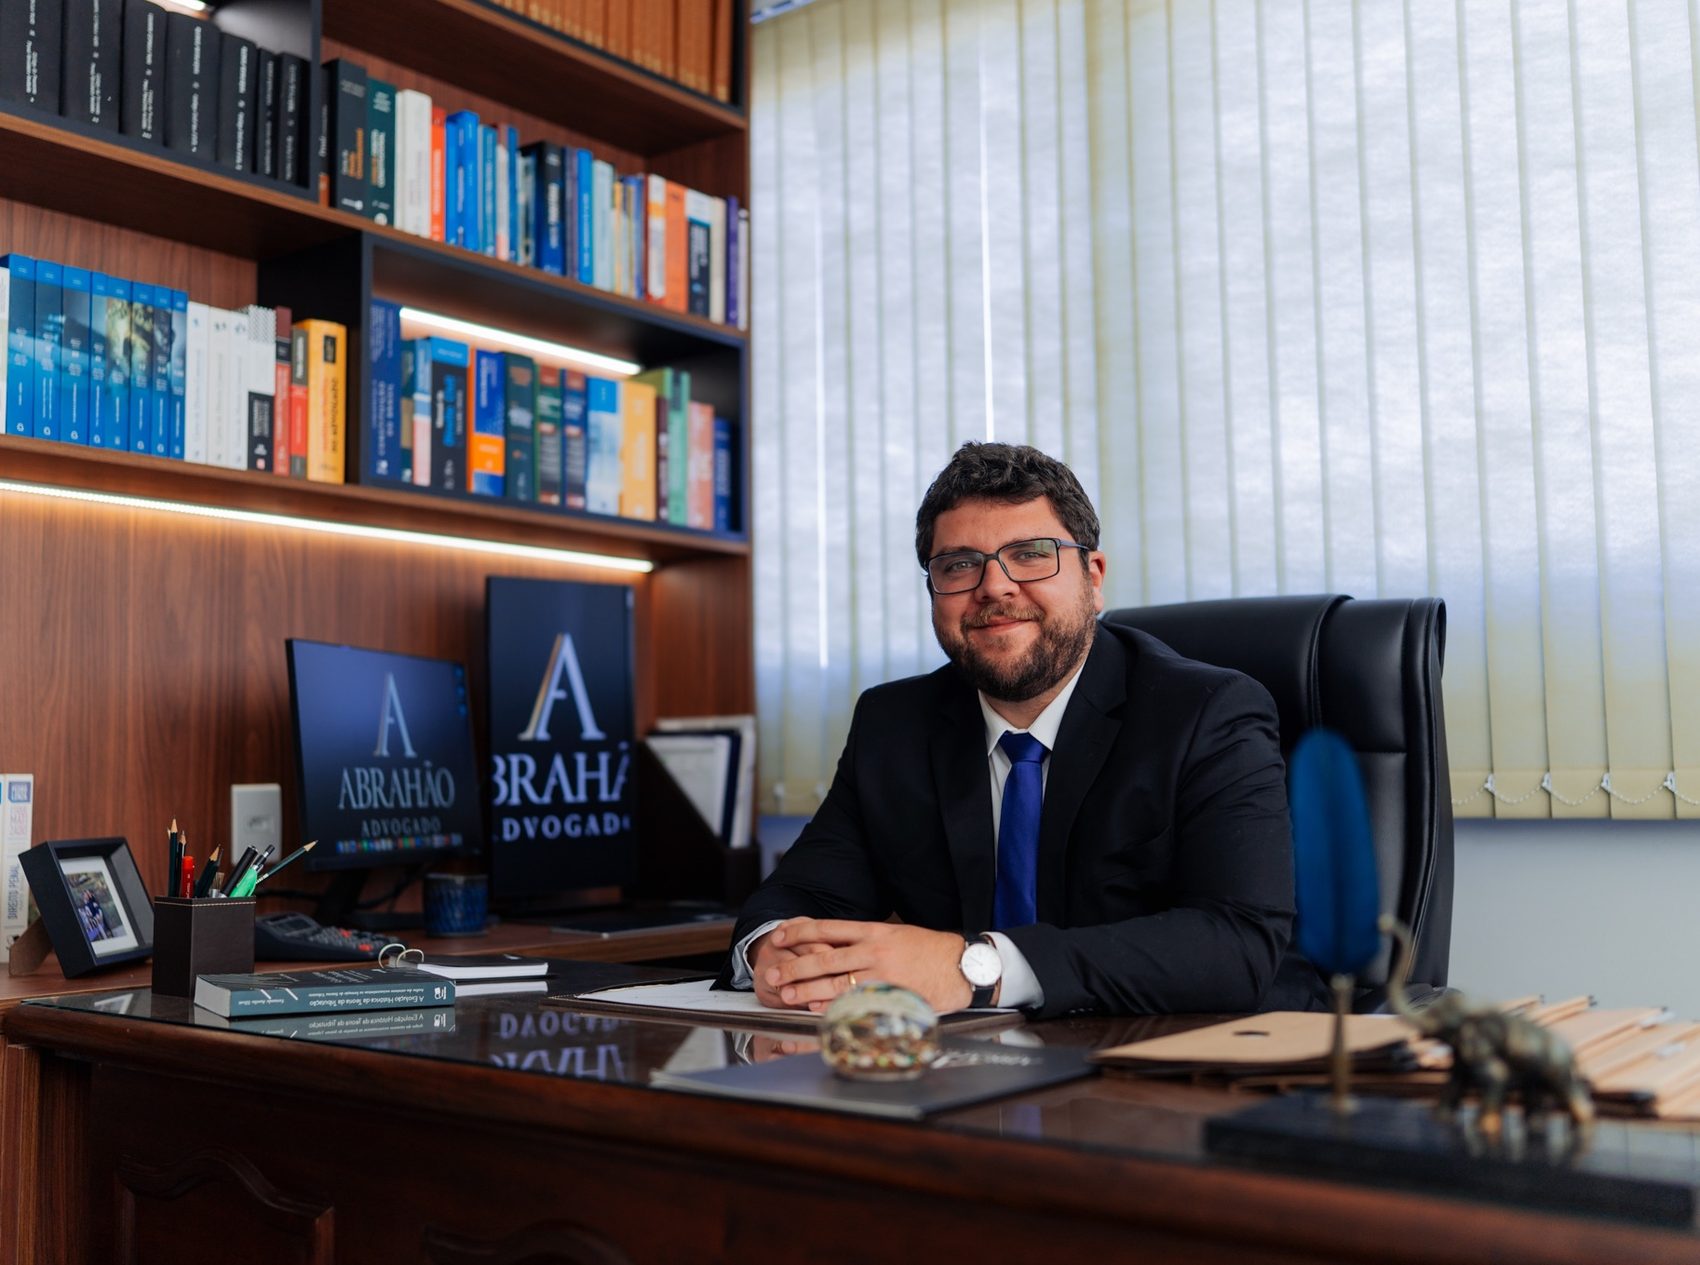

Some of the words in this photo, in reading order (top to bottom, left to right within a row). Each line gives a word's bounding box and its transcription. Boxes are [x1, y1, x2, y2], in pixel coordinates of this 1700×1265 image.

[338, 760, 455, 810] ABRAHÃO
[361, 816, 442, 838] ADVOGADO
[492, 812, 631, 842] DVOGAD
